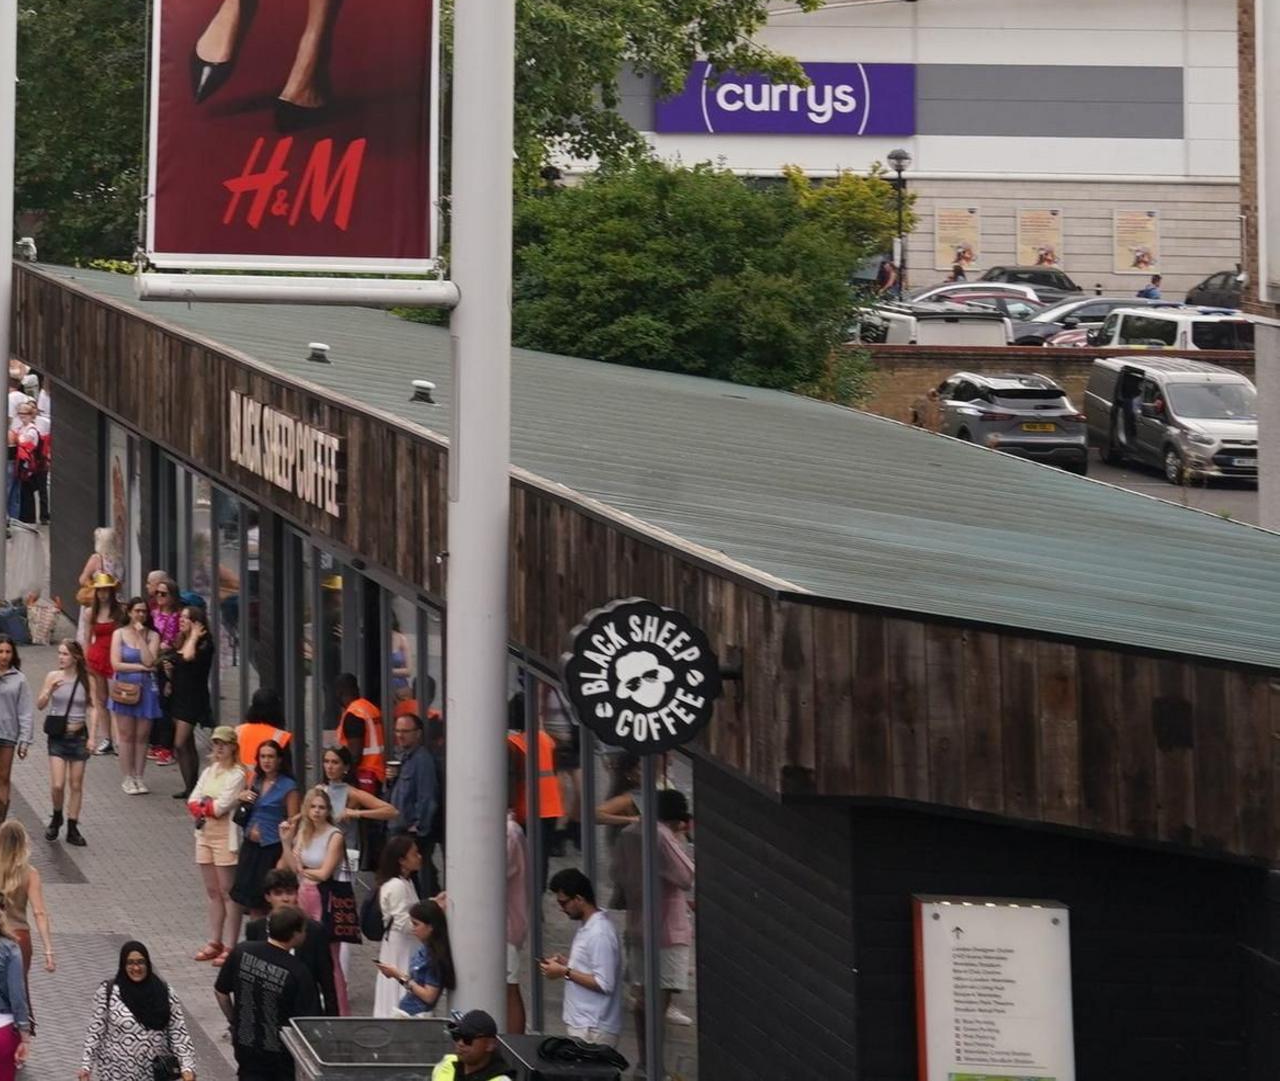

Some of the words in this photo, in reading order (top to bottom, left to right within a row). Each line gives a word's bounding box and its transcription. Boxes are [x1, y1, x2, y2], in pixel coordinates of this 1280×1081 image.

[716, 83, 857, 124] currys
[223, 137, 367, 231] H&M
[230, 390, 263, 476] BLACK
[263, 405, 295, 493] SHEEP
[296, 421, 340, 518] COFFEE
[579, 622, 628, 696] BLACK
[628, 615, 701, 661] SHEEP
[615, 688, 705, 742] COFFEE
